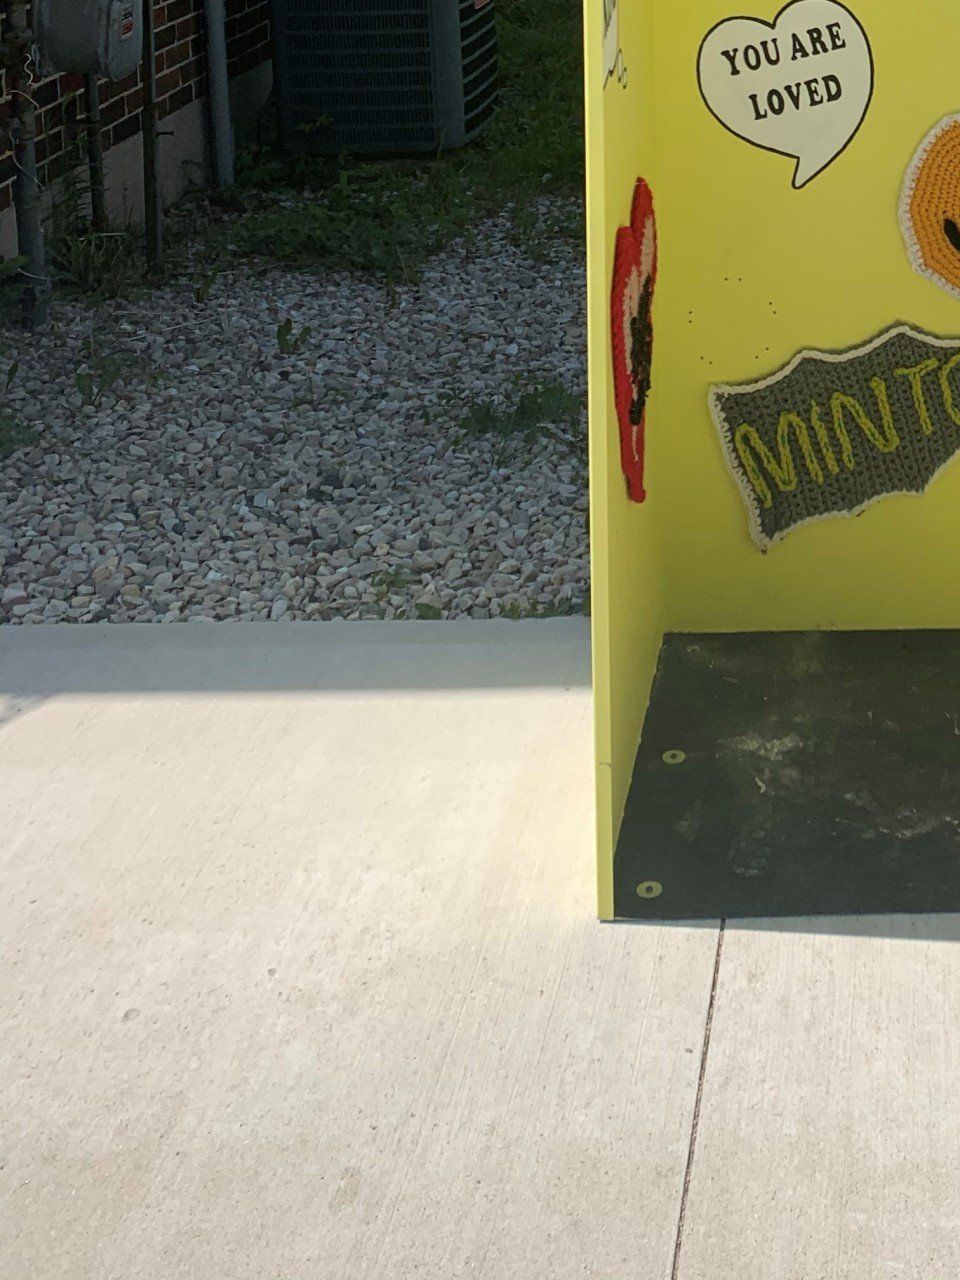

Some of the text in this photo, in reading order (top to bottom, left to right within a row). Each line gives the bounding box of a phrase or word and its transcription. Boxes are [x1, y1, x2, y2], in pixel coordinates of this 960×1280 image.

[721, 22, 846, 76] YOU ARE
[748, 74, 843, 120] LOVED
